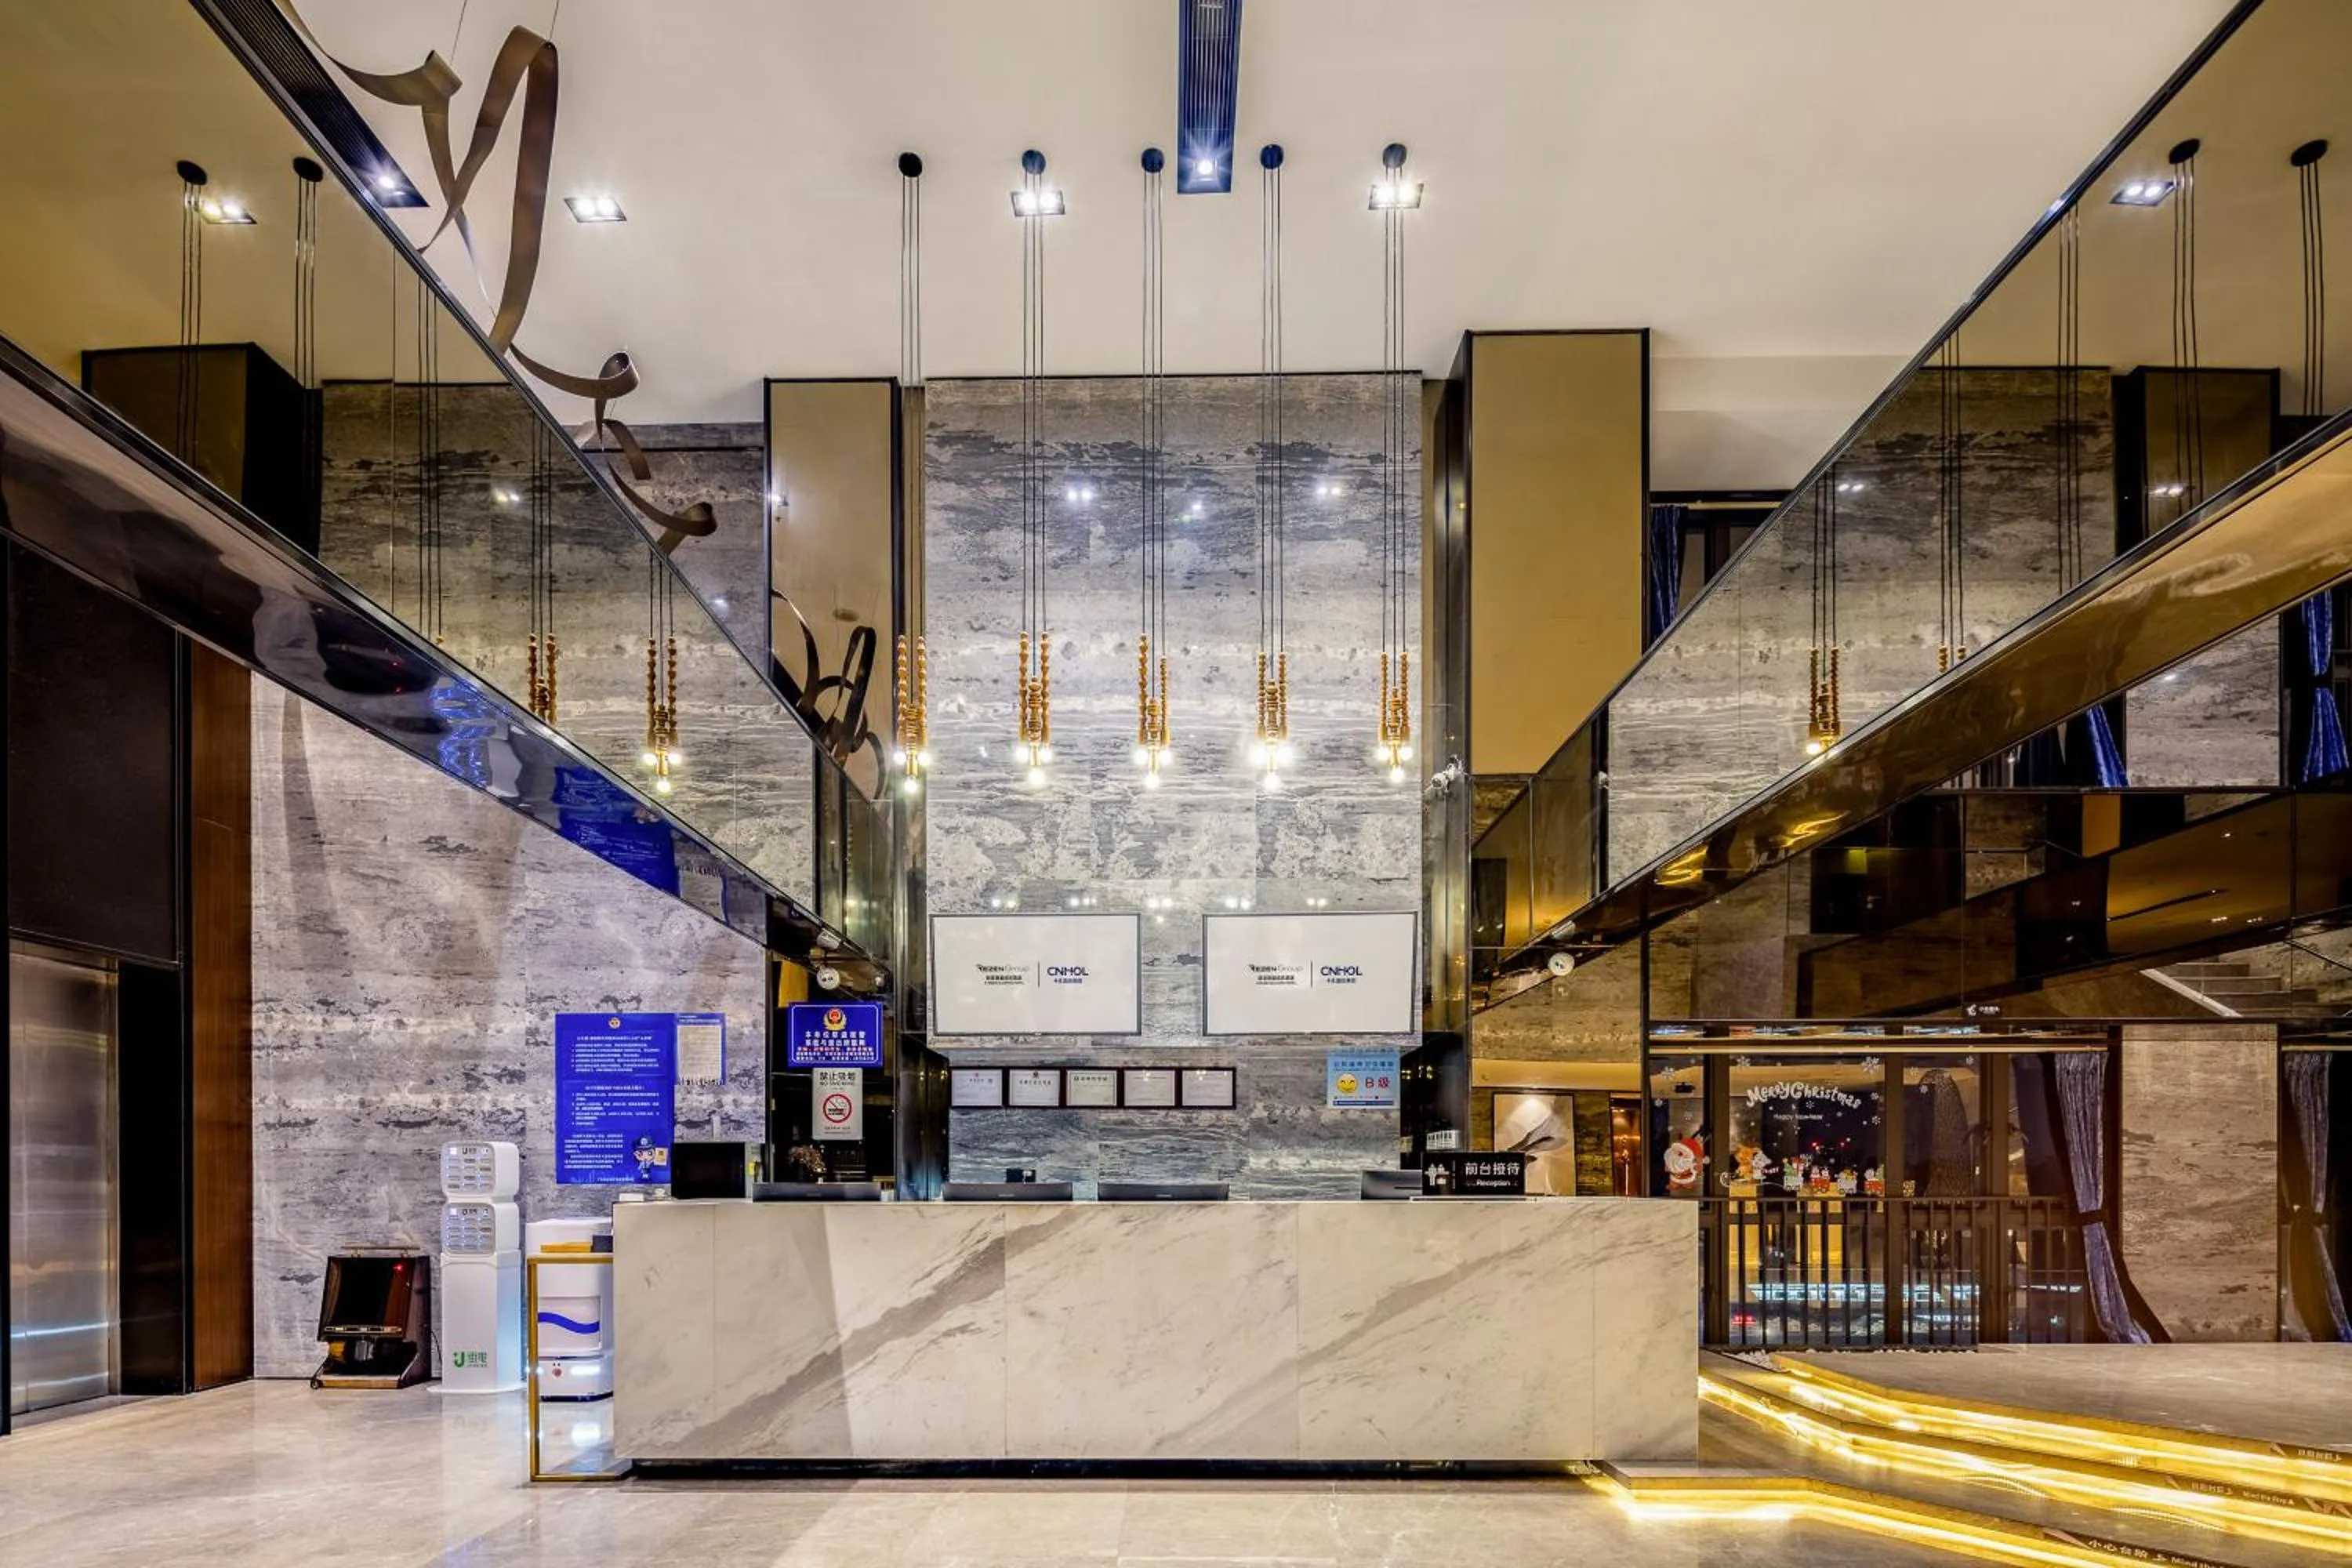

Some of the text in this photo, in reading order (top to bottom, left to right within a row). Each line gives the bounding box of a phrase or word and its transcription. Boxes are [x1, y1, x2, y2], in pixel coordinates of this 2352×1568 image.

[1047, 966, 1089, 976] CNHOL
[1320, 966, 1363, 976] CNHOL
[1465, 1161, 1520, 1175] 前台接待
[2088, 1538, 2148, 1559] 小心台阶
